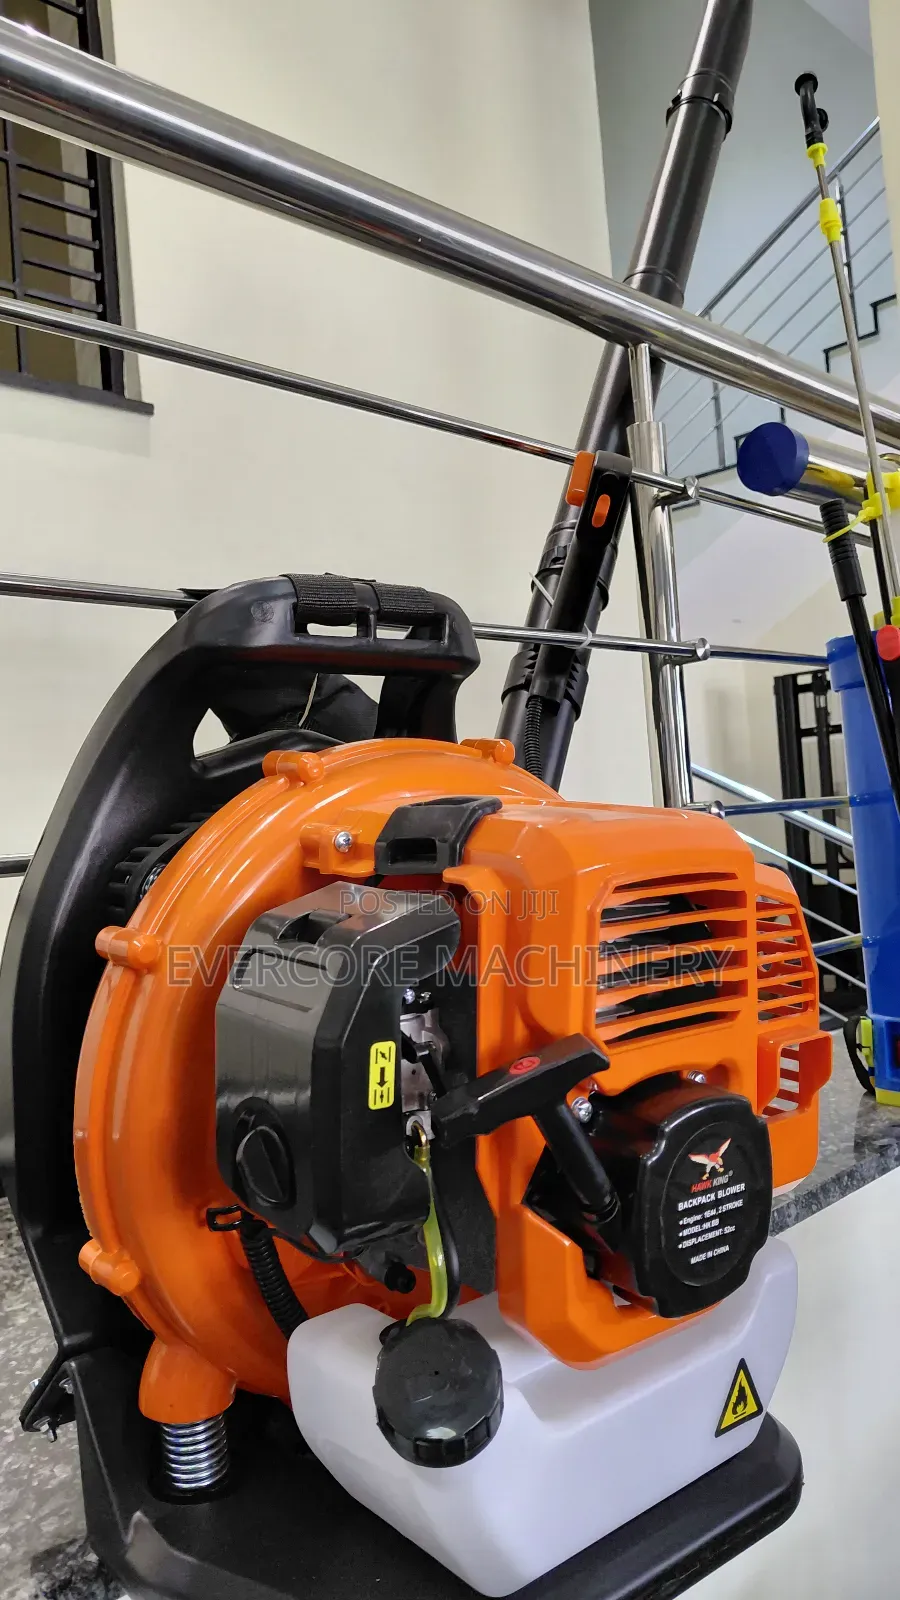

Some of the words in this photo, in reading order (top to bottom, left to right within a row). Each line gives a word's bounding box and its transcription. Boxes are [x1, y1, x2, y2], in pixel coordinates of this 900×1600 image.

[678, 1193, 716, 1211] BACKPACK
[717, 1183, 745, 1199] BLOWER
[690, 1180, 712, 1193] HAWK
[722, 1199, 743, 1212] STROKE
[682, 1228, 724, 1249] DISPLACEMENT:
[690, 1252, 707, 1265] MADE
[706, 1250, 713, 1259] IN
[713, 1244, 730, 1257] CHINA
